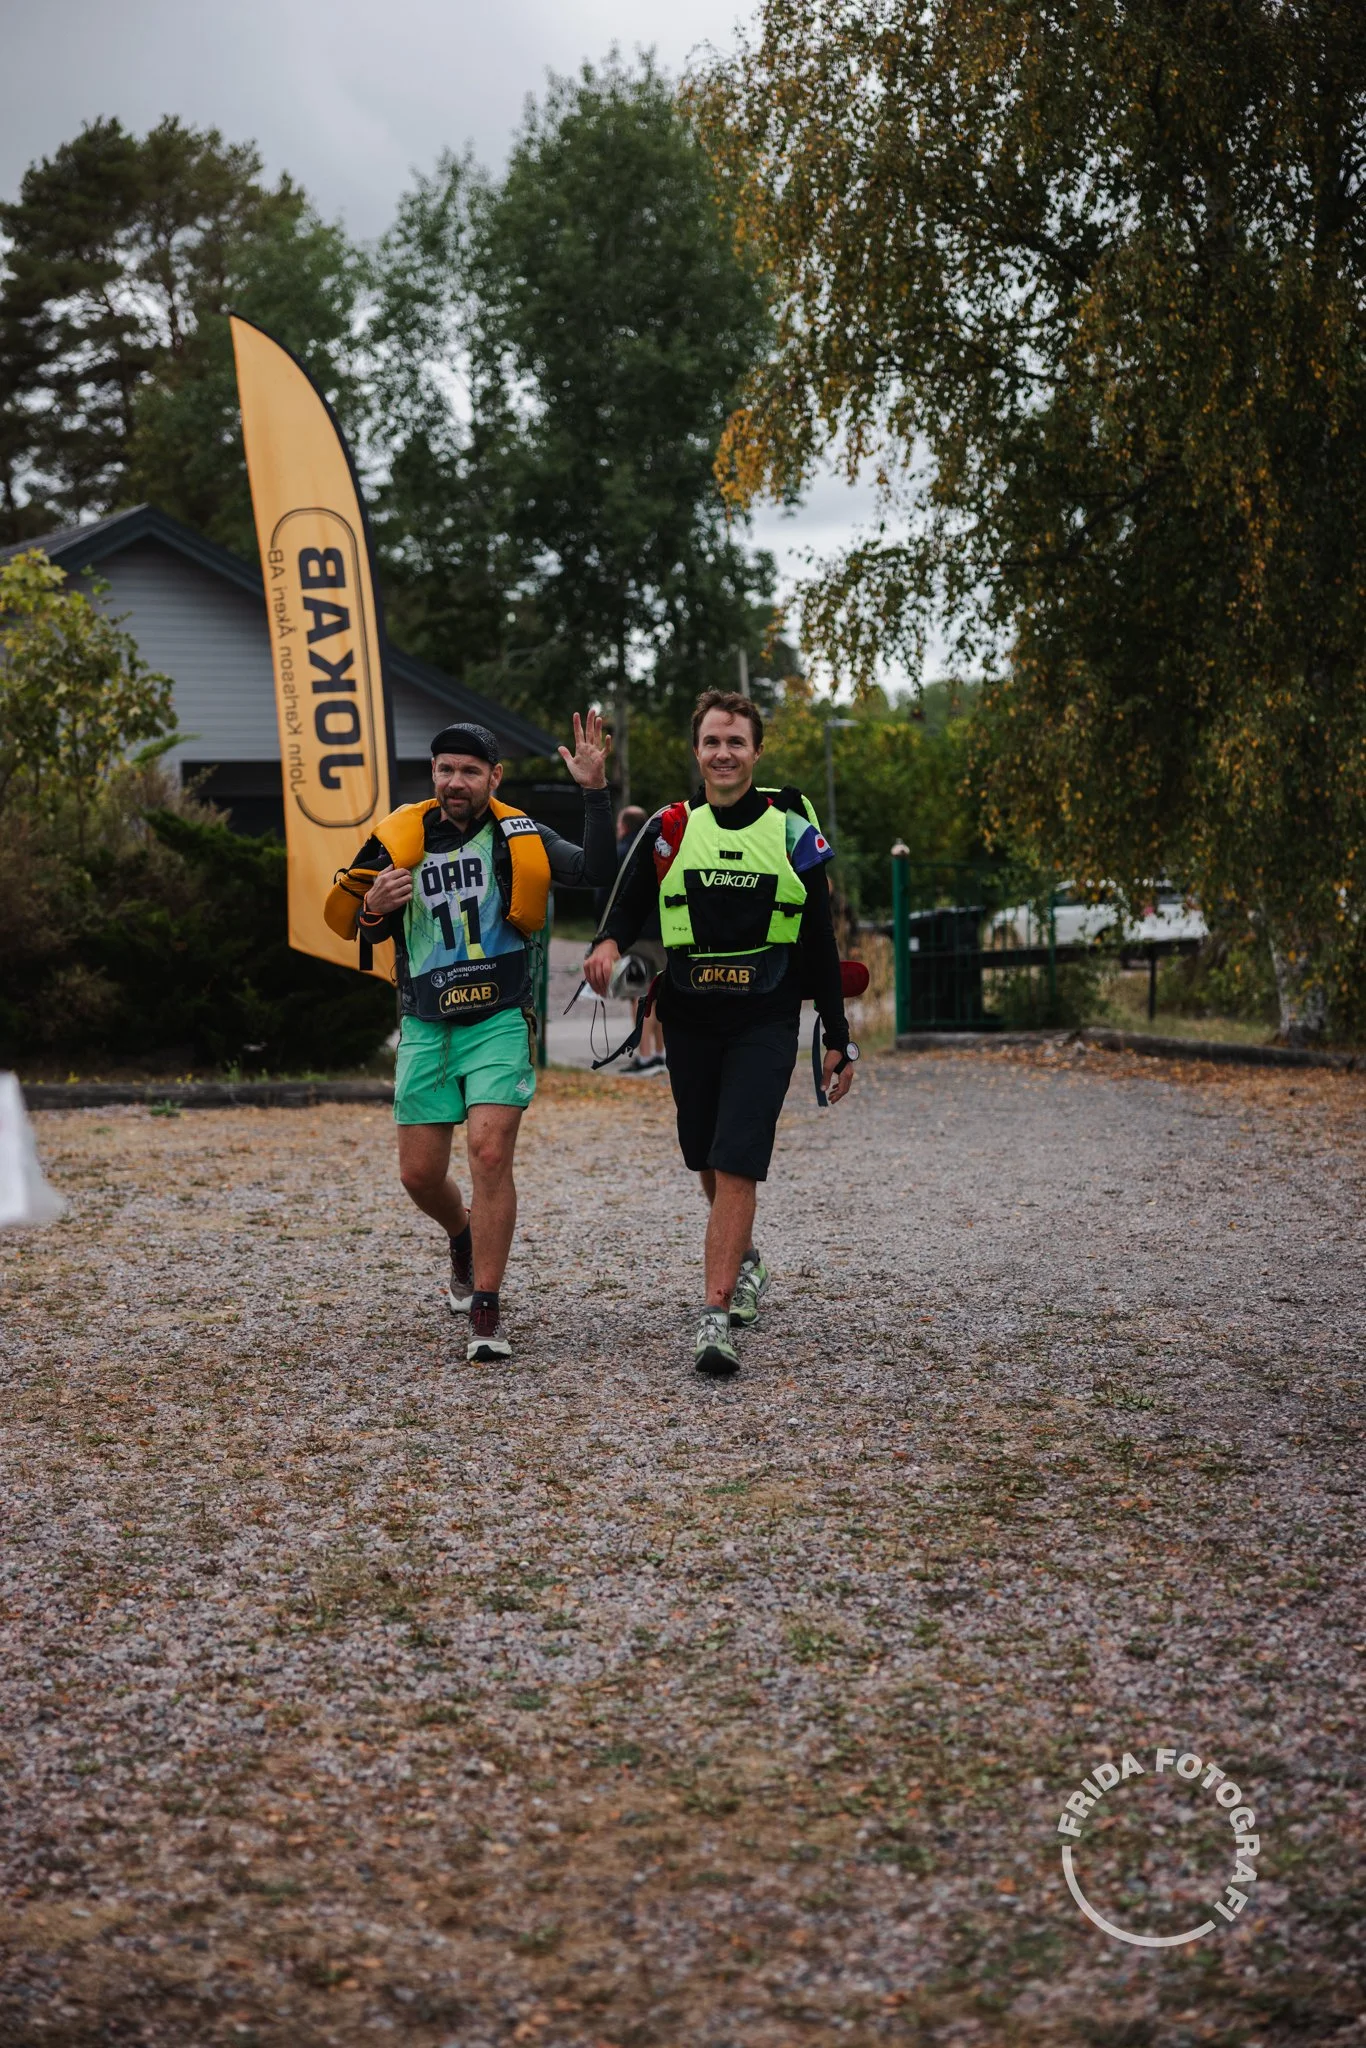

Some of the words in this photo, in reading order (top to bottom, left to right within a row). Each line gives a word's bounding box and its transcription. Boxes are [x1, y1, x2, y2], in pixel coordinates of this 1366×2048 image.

[509, 819, 534, 831] HH
[421, 857, 484, 897] ÖAR
[699, 870, 760, 889] Vaikobi
[431, 895, 482, 951] 11
[698, 968, 750, 984] JOKAB
[445, 986, 492, 1006] JOKAB
